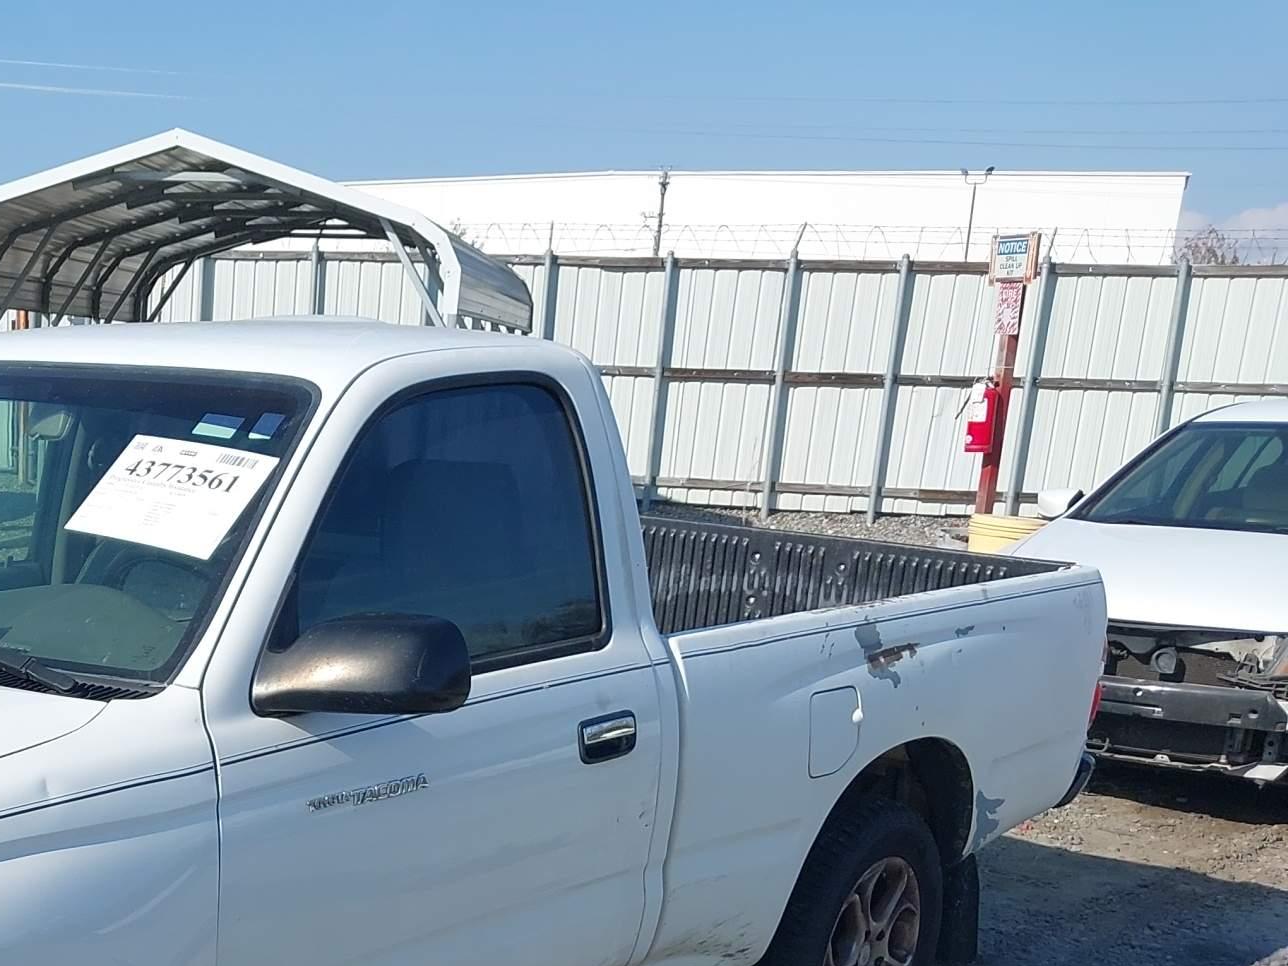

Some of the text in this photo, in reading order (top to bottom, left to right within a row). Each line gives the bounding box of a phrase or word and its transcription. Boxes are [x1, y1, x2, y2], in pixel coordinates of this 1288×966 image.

[998, 241, 1028, 254] NOTICE
[125, 459, 240, 492] 43773561
[351, 773, 430, 806] TACOMA
